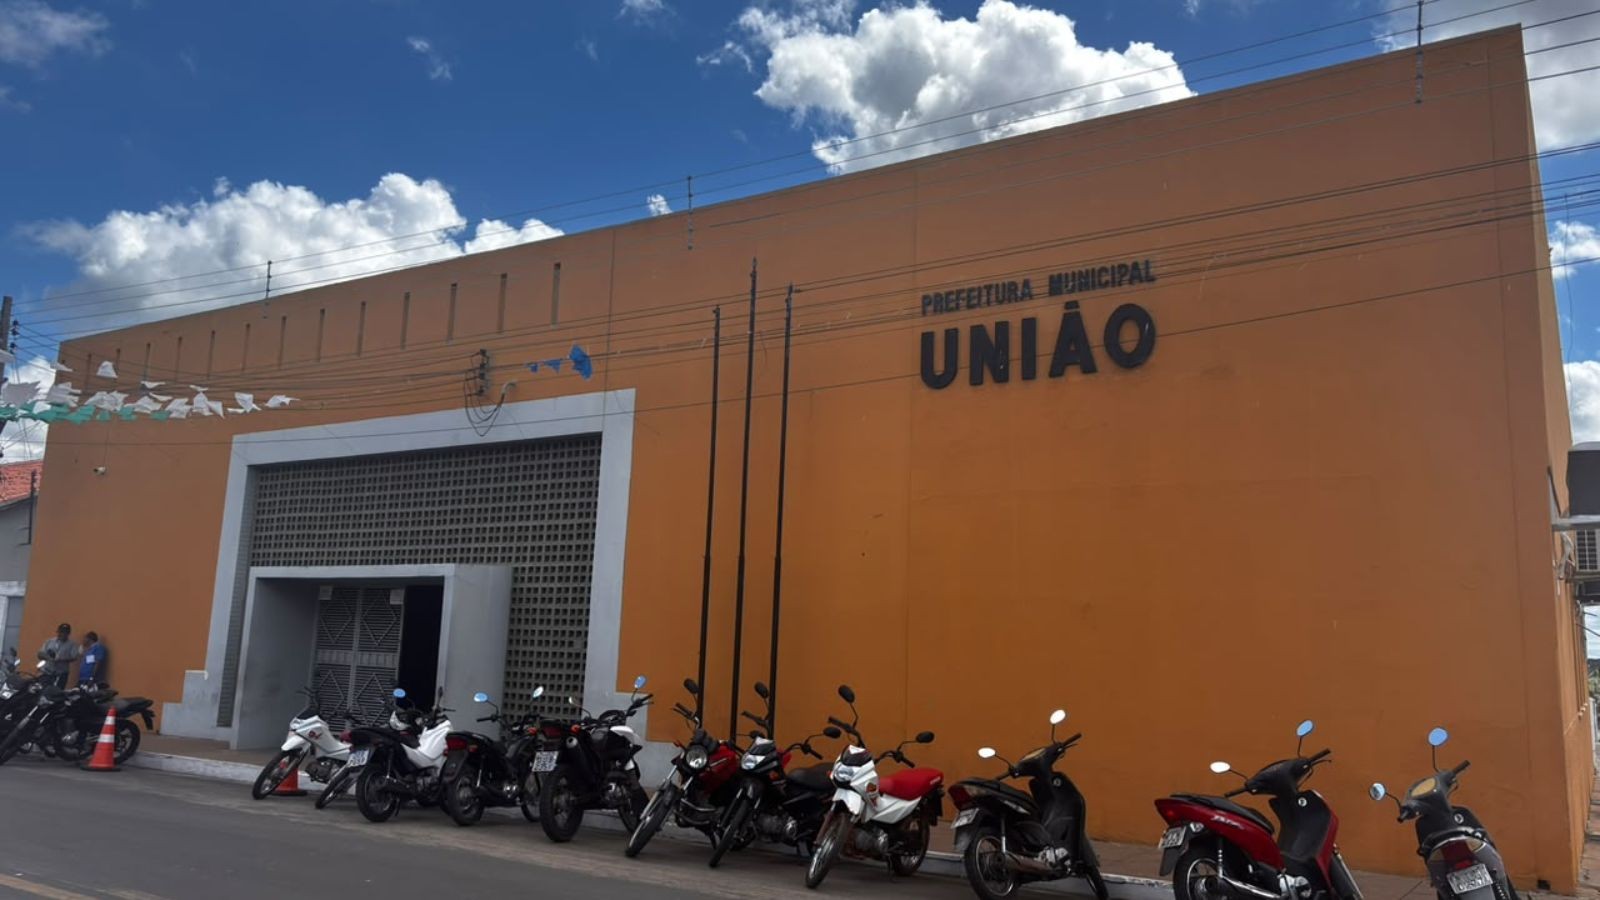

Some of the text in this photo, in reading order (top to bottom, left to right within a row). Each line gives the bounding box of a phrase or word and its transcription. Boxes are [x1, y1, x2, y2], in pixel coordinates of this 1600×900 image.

[922, 259, 1156, 316] PREFEITURA MUNICIPAL
[921, 300, 1156, 389] UNIÃO
